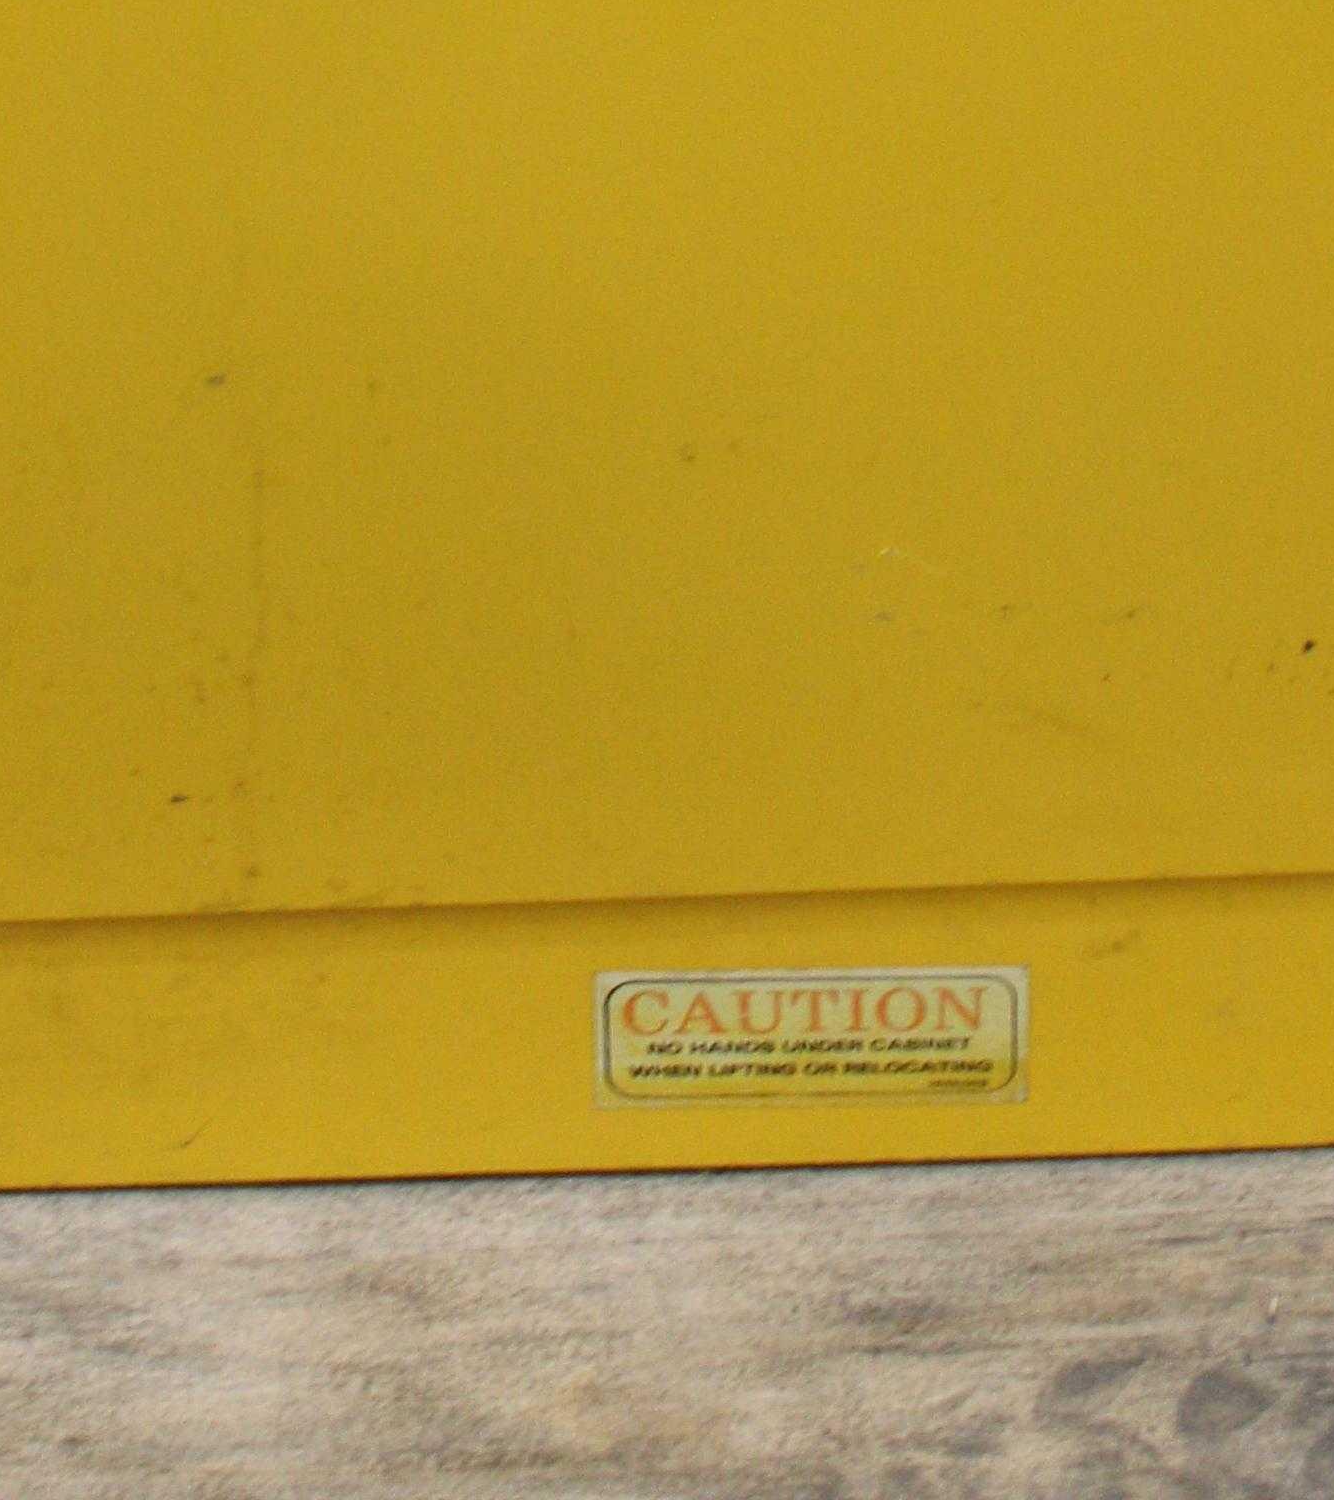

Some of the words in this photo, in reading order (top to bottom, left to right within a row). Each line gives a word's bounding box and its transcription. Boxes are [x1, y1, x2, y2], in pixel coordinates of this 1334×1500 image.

[621, 986, 989, 1035] CAUTION
[646, 1040, 682, 1055] NO
[688, 1039, 775, 1055] HANDS
[781, 1038, 864, 1054] UNDER
[870, 1036, 971, 1052] CABINET
[629, 1062, 702, 1079] WHEN
[708, 1061, 797, 1078] LIFTING
[803, 1060, 838, 1076] OR
[844, 1059, 995, 1075] RELOCATING
